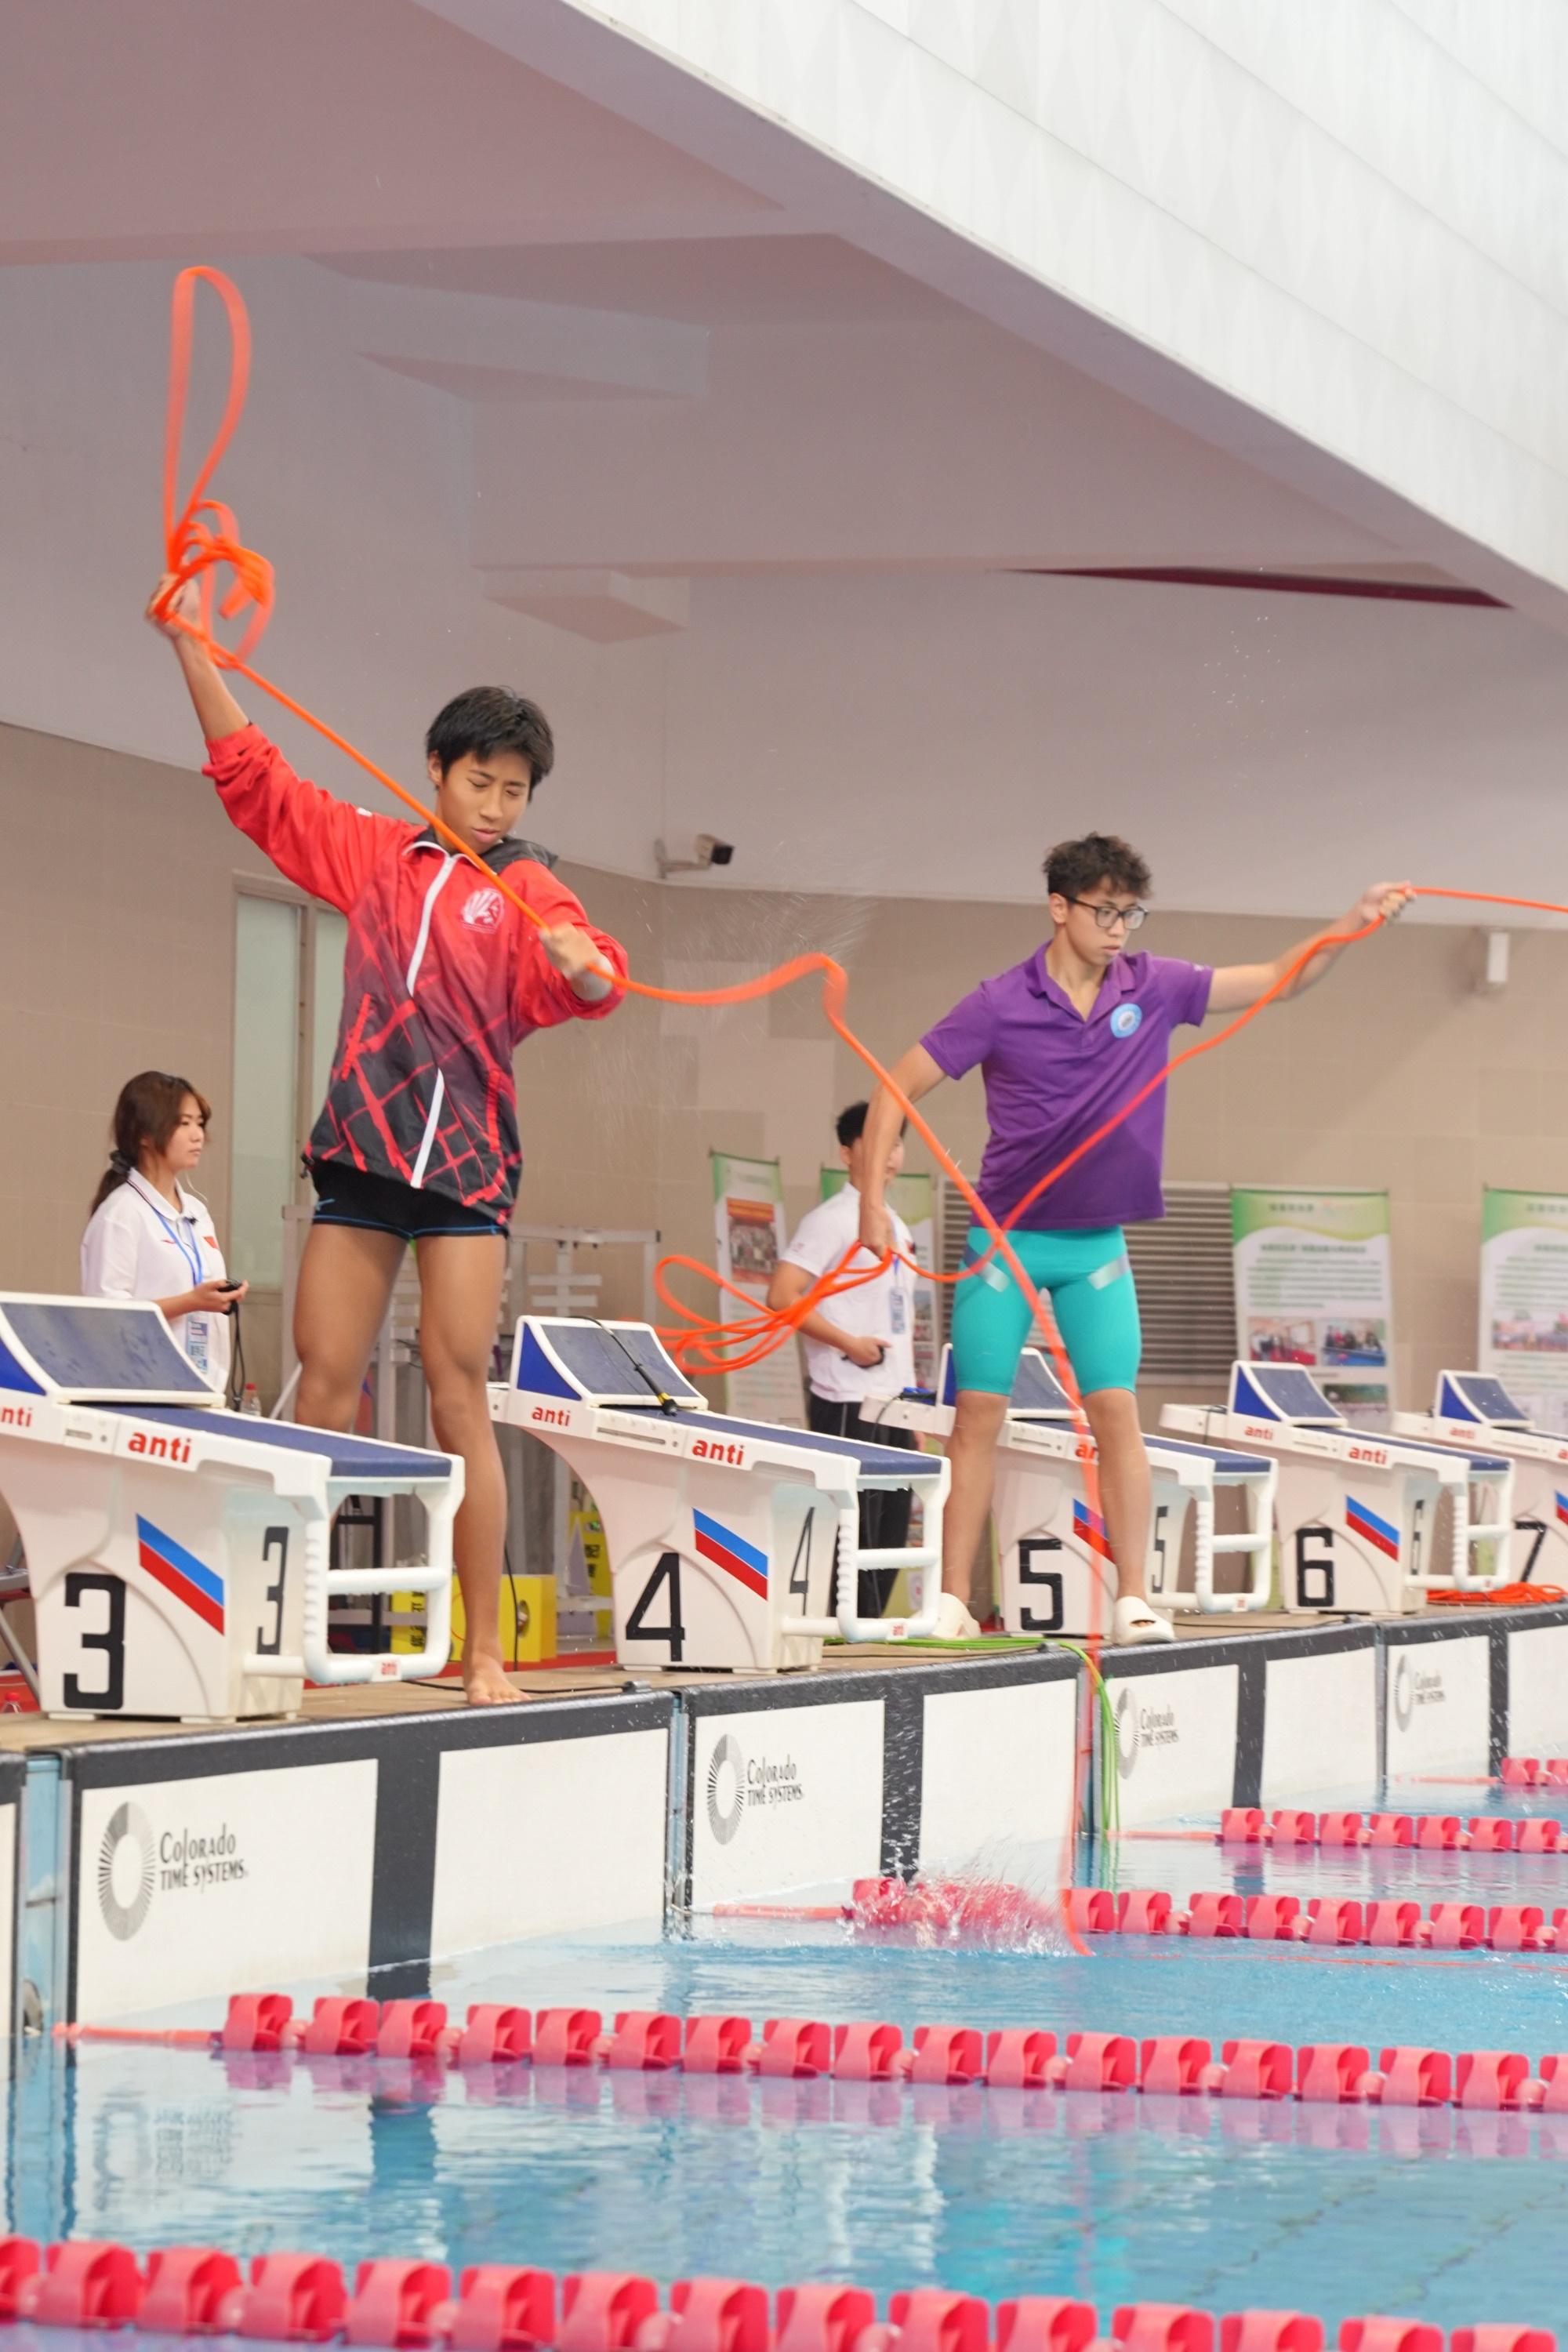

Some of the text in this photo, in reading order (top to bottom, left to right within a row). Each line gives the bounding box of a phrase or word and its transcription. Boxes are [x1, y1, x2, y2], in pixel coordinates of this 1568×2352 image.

[0, 1406, 33, 1427] nti
[128, 1432, 192, 1463] anti
[532, 1406, 571, 1427] anti
[1244, 1425, 1273, 1439] anti
[691, 1439, 744, 1465] anti
[1348, 1446, 1388, 1465] anti
[789, 1506, 815, 1616] 4
[1152, 1505, 1169, 1594] 5
[1295, 1527, 1334, 1608] 6
[1513, 1520, 1547, 1582] 7
[256, 1526, 289, 1656] 3
[625, 1552, 685, 1662] 4
[1018, 1538, 1064, 1632] 5
[64, 1572, 127, 1710] 3
[160, 1859, 245, 1893] TIME SYSTEMS
